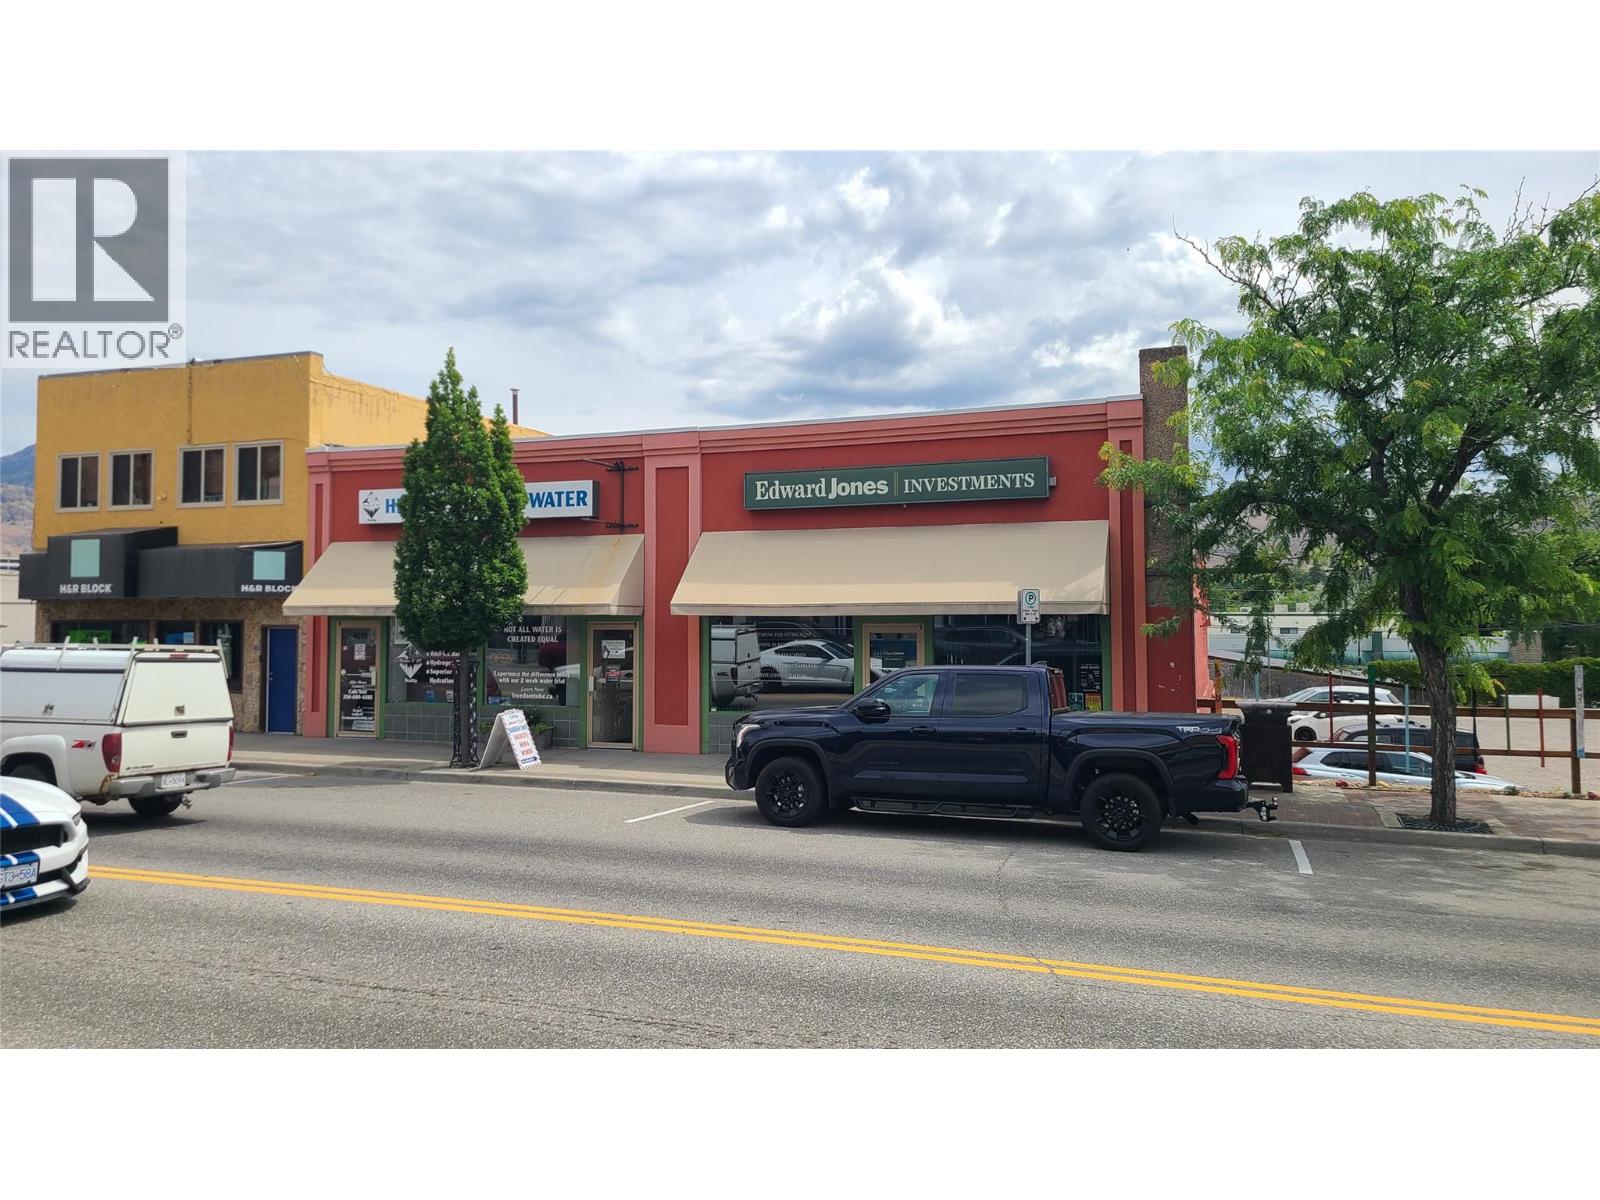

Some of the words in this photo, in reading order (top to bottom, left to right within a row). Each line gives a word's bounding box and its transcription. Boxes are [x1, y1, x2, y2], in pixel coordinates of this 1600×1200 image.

[755, 478, 826, 500] Edward
[828, 477, 889, 499] Jones
[903, 472, 1035, 493] INVESTMENTS
[528, 490, 588, 508] WATER
[59, 584, 79, 594] H&R
[80, 583, 112, 593] BLOCK
[241, 584, 263, 592] H&R
[507, 635, 536, 643] CREATED
[537, 635, 559, 644] EQUAL
[493, 670, 521, 678] Experience
